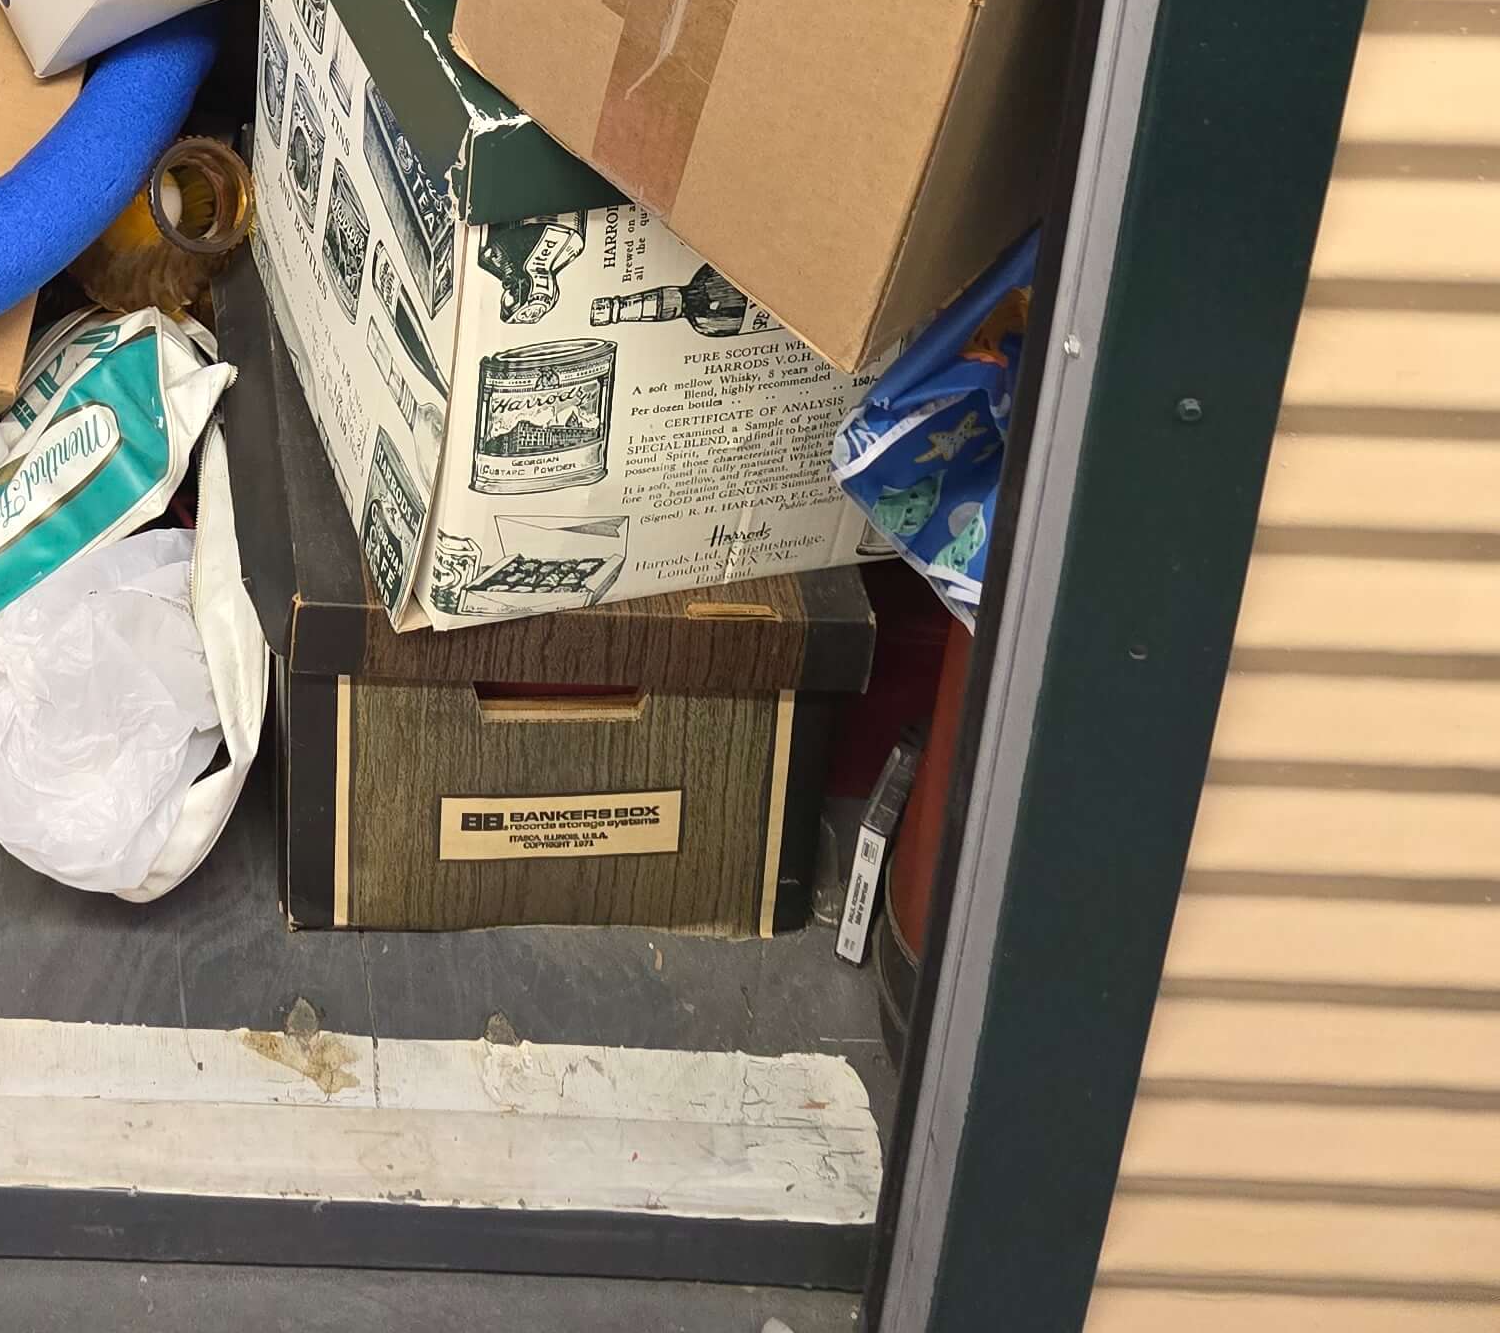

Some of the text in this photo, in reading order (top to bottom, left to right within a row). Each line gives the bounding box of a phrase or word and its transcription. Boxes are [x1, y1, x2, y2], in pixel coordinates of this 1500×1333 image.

[289, 21, 350, 156] FRUITS IN TINS
[412, 178, 434, 232] TEA
[295, 214, 327, 300] BOTTLES
[622, 219, 635, 283] Brewed on
[636, 242, 645, 280] all the
[684, 344, 779, 364] PURE SCOTCH
[704, 352, 814, 375] HARRODS V.O.H.
[632, 386, 642, 395] A
[649, 381, 667, 393] soft
[674, 377, 712, 390] mellow
[720, 371, 762, 385] Whisky,
[781, 367, 808, 382] years
[684, 372, 831, 400] Blend, highly recommended
[631, 398, 723, 416] Per dozen bottles
[664, 395, 844, 428] CERTIFICATE OF ANALYSIS
[641, 432, 667, 445] have
[672, 425, 724, 440] examined
[745, 418, 784, 438] Sample
[790, 413, 802, 424] of
[807, 411, 831, 424] your
[624, 463, 677, 478] possessing
[713, 447, 788, 464] characteristics
[792, 441, 822, 454] which
[625, 453, 657, 466] sound
[666, 450, 699, 464] Spirit,
[770, 436, 783, 447] all
[627, 438, 684, 455] SPECIAL
[662, 469, 693, 481] found
[711, 460, 735, 474] fully
[740, 455, 784, 469] matured
[375, 443, 412, 521] HARRODS
[624, 486, 635, 495] It
[720, 472, 740, 483] and
[649, 491, 662, 500] no
[669, 483, 719, 498] hesitation
[653, 496, 692, 509] GOOD
[696, 492, 715, 503] and
[718, 483, 778, 500] GENUINE
[640, 509, 684, 525] (Signed)
[704, 521, 772, 547] Harrods
[635, 553, 690, 572] Harrods
[657, 562, 711, 580] London
[509, 805, 660, 822] BANKERS BOX
[510, 816, 660, 830] records storage systems
